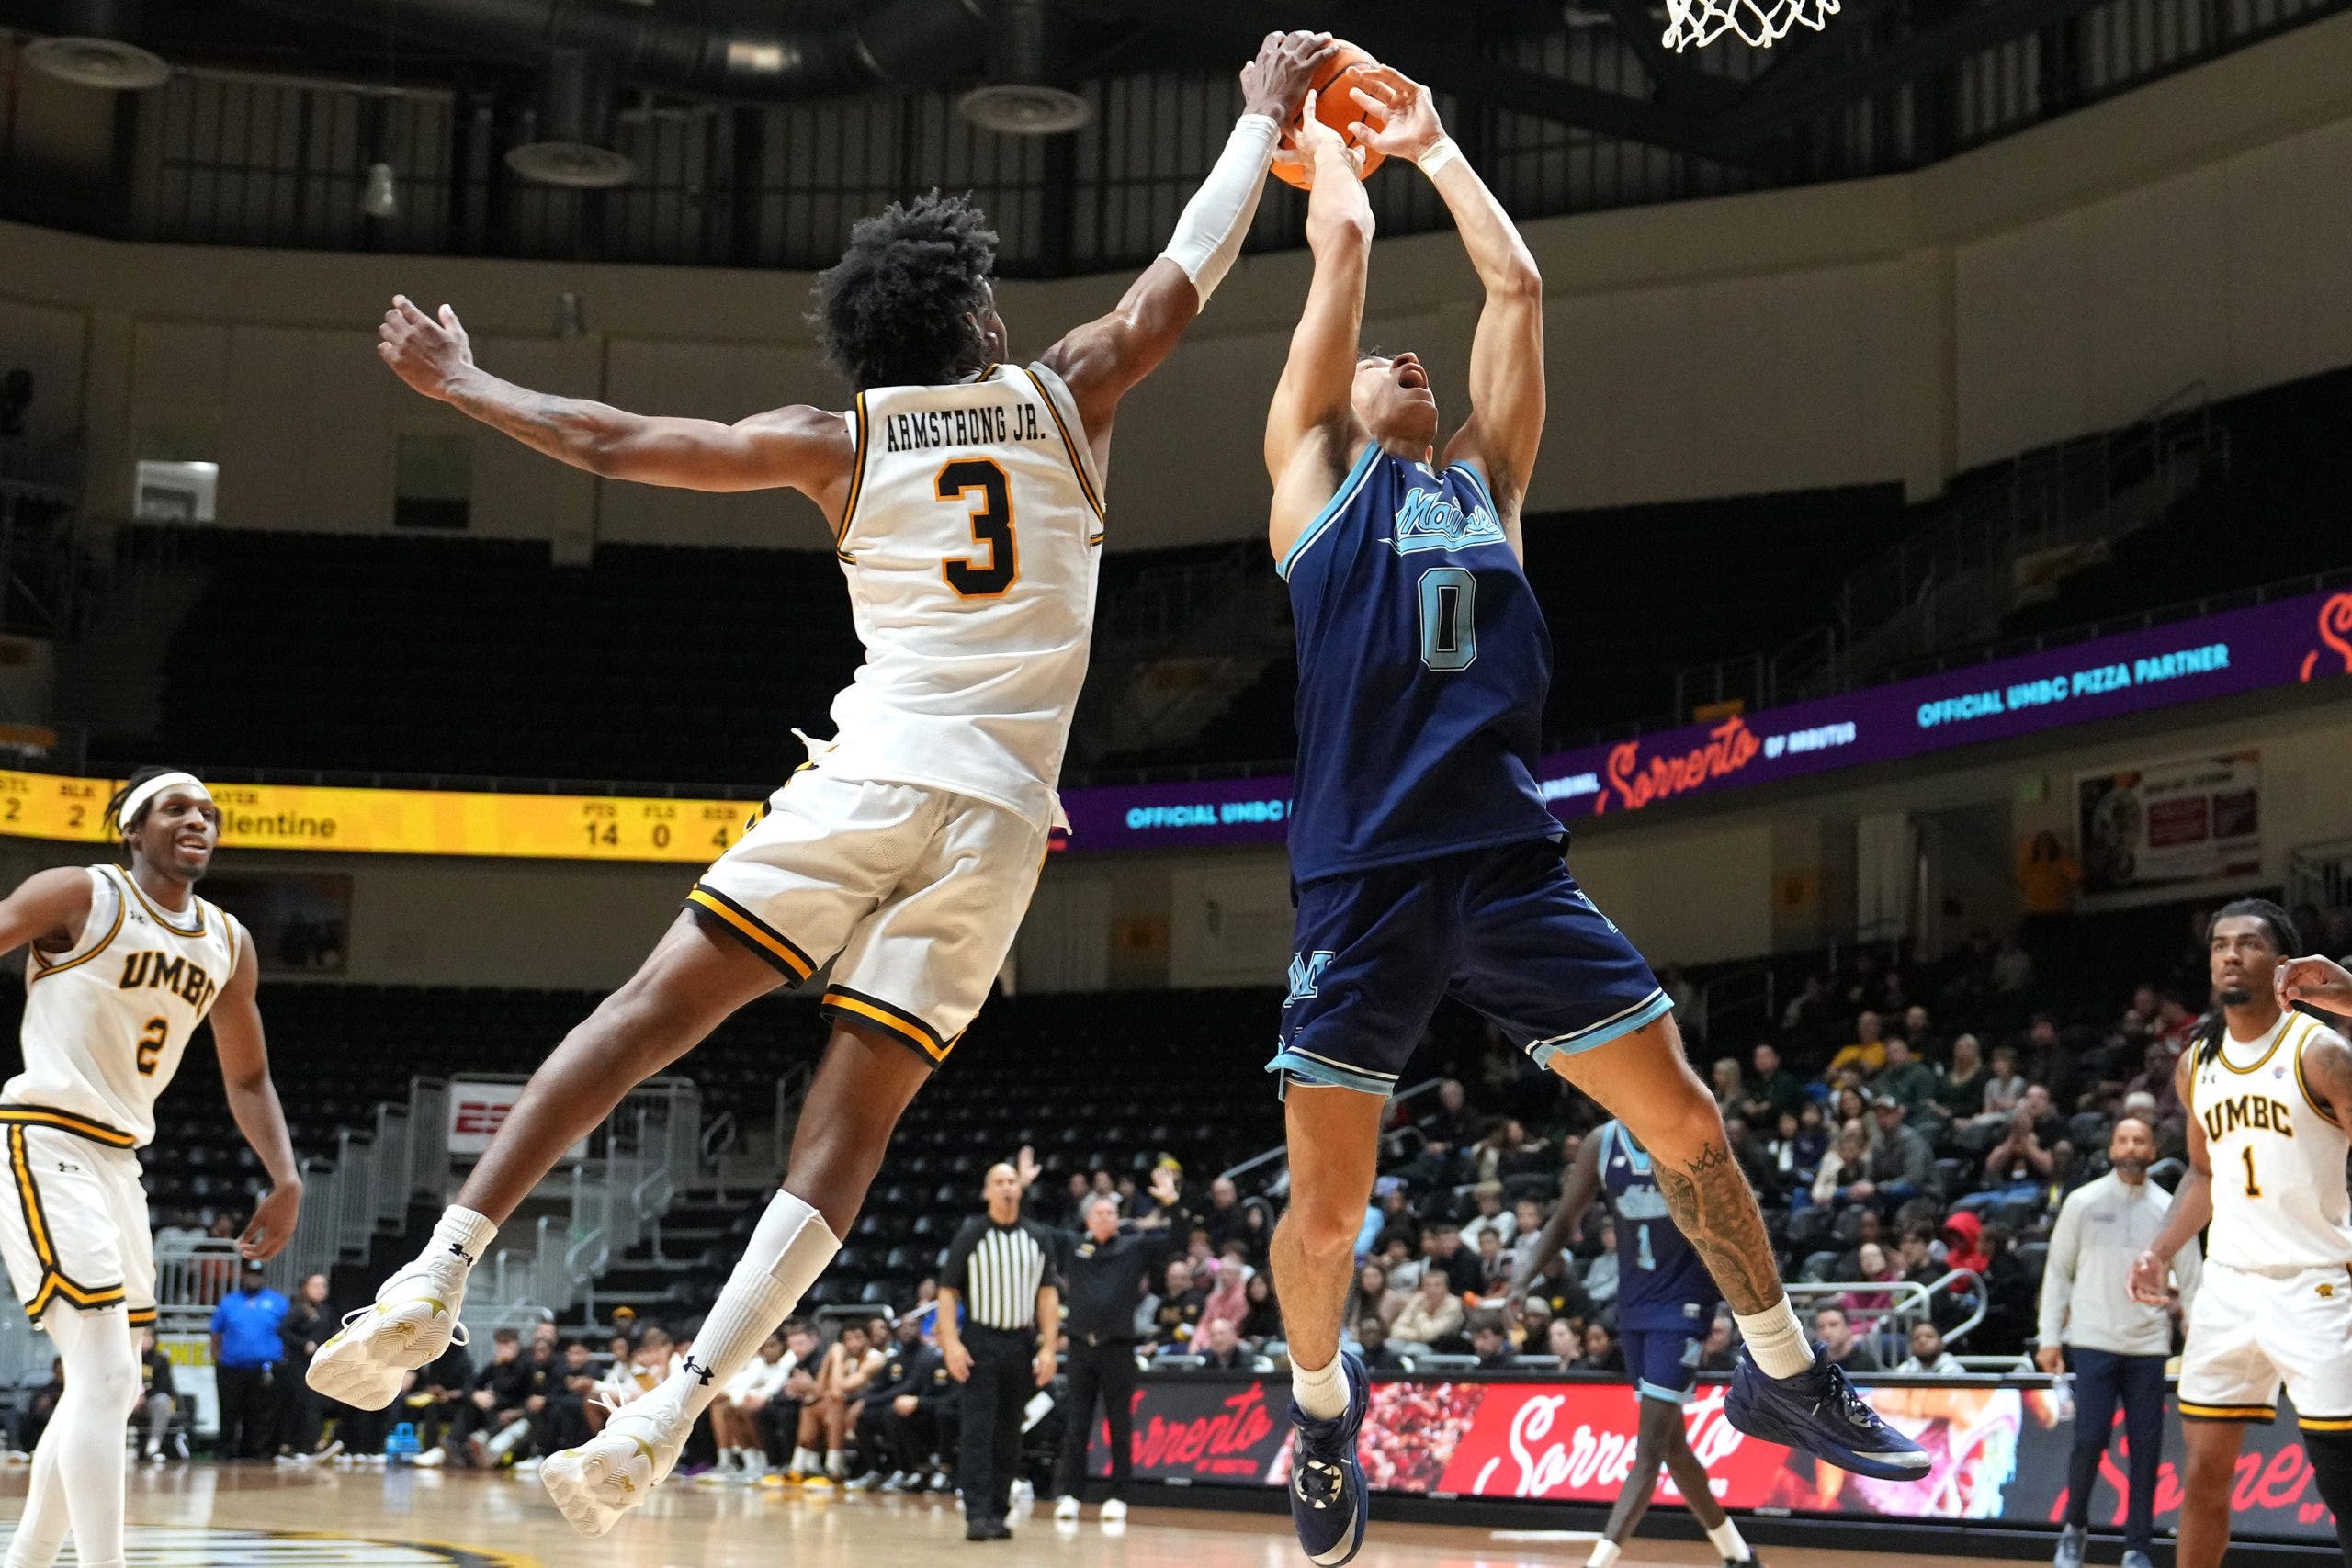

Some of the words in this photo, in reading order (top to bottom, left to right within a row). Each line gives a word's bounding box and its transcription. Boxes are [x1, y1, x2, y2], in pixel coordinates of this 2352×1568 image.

[888, 406, 1007, 452] ARMSTRONG
[1013, 402, 1046, 442] JR.
[933, 456, 1020, 600] 3
[1418, 567, 1478, 672] 0
[1917, 689, 2005, 728] OFFICIAL
[2007, 676, 2069, 711] UMBC
[2072, 662, 2132, 697] PIZZA
[2134, 643, 2231, 685] PARTNER
[1595, 715, 1761, 816] Sorrento
[6, 796, 22, 822] 2
[68, 804, 86, 829] 2
[226, 809, 337, 838] lentine
[585, 822, 618, 847] 14
[651, 823, 672, 850] 0
[711, 826, 729, 849] 4
[135, 1014, 169, 1078] 2
[2204, 1094, 2294, 1143] UMBC
[2242, 1145, 2263, 1199] 1
[1636, 1223, 1657, 1271] 1
